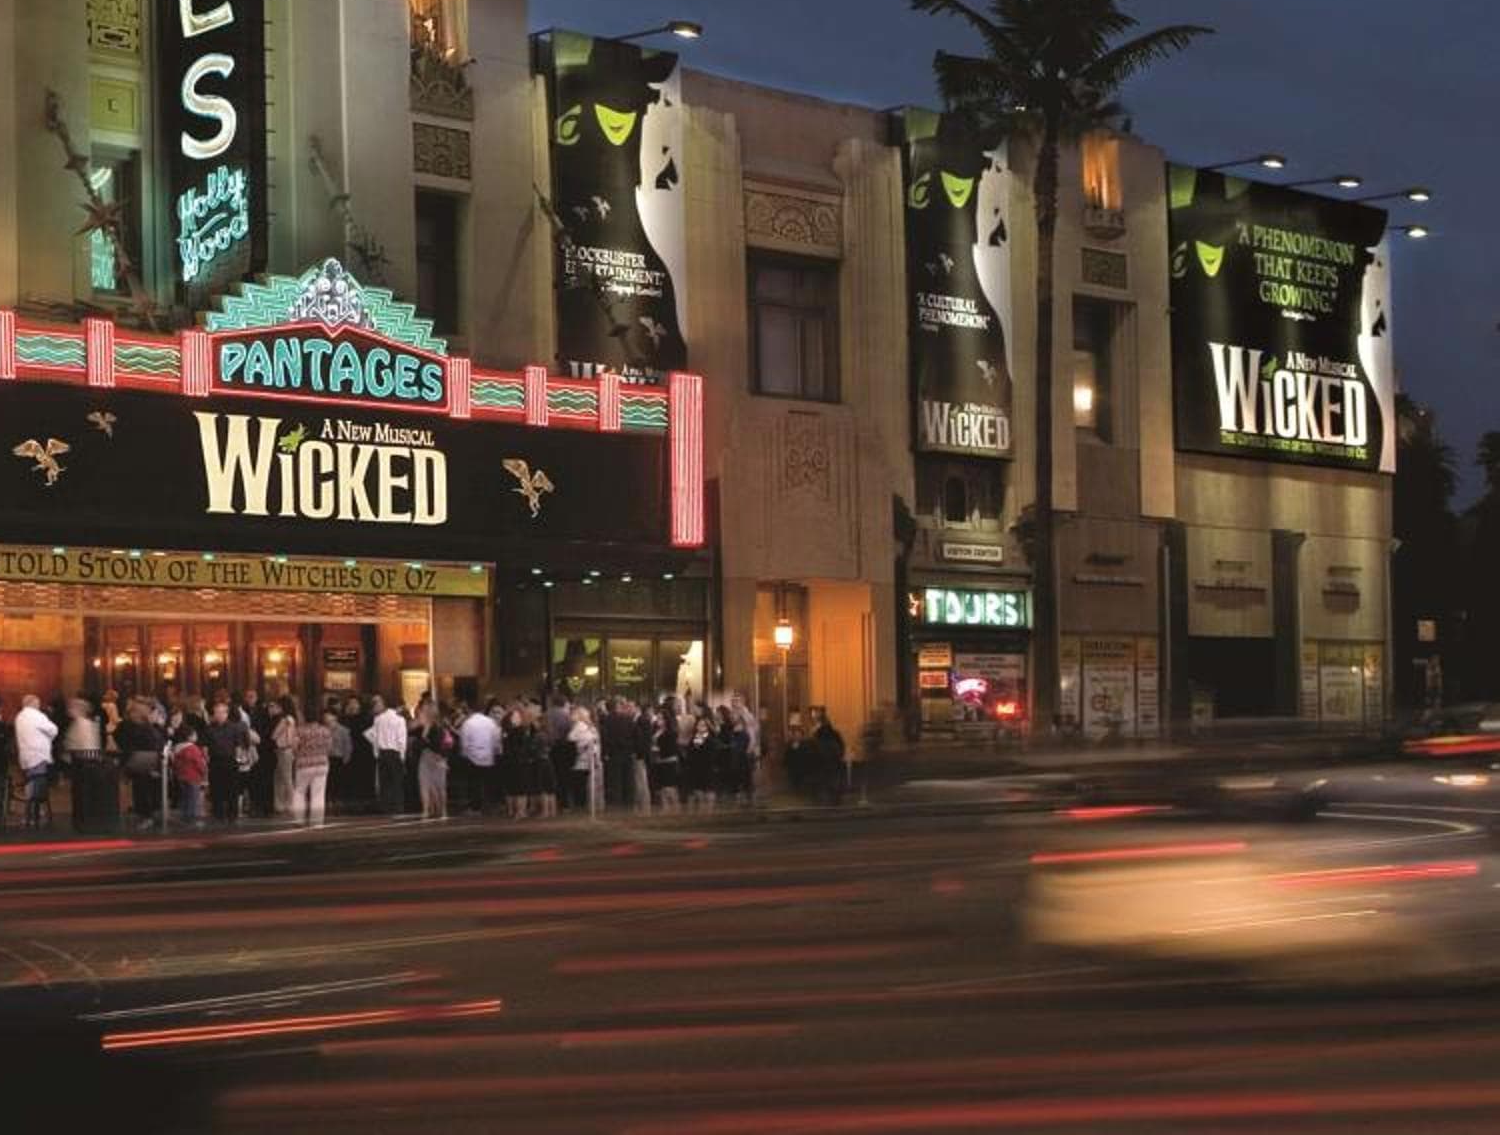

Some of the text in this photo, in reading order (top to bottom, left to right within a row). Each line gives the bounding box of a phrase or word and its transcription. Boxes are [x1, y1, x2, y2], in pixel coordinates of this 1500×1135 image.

[1253, 225, 1355, 265] PHENOMENON
[1253, 252, 1338, 288] THAT KEEPS
[220, 338, 443, 402] PANTAGES
[321, 418, 334, 439] A
[78, 552, 159, 581] STORY
[167, 560, 198, 582] OF
[210, 561, 251, 584] THE
[260, 559, 362, 589] WITCHES
[369, 567, 398, 589] OF
[925, 588, 1020, 626] TOURS
